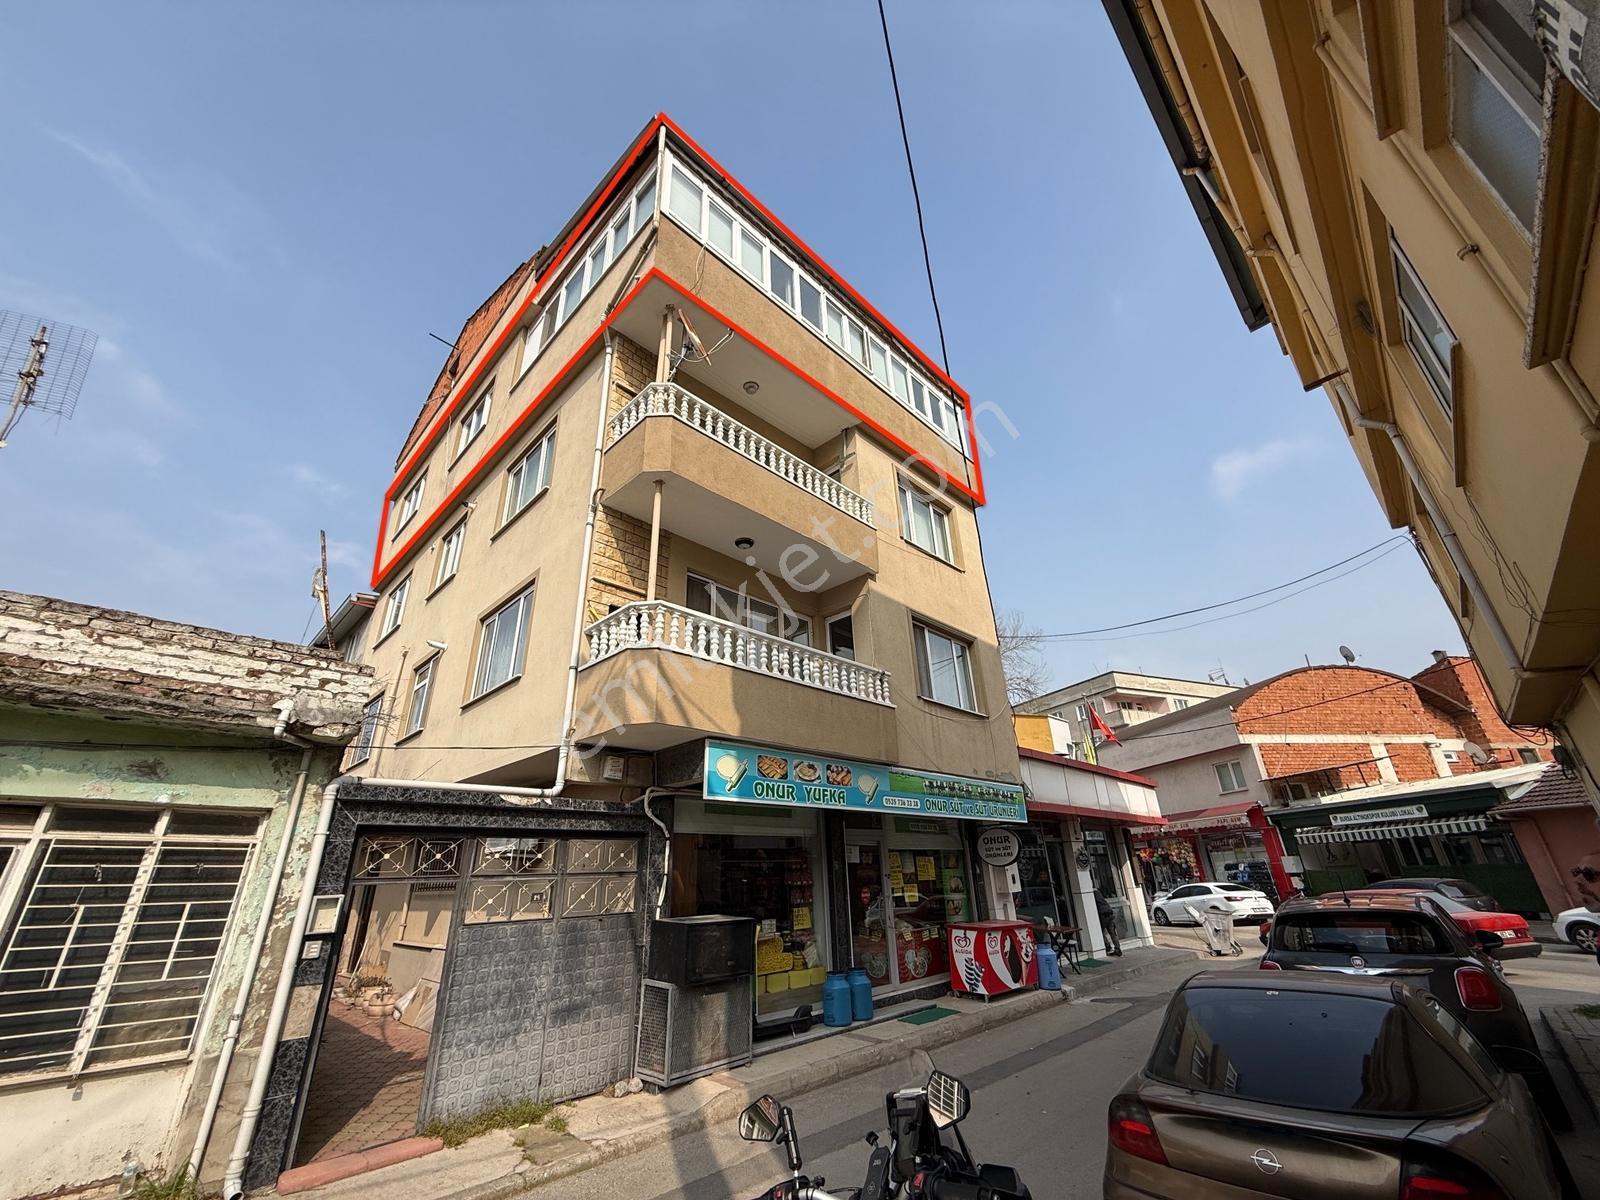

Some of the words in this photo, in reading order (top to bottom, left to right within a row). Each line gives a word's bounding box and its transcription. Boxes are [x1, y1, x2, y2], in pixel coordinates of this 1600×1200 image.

[753, 781, 796, 803] ONUR
[804, 785, 846, 806] YUFKA
[925, 798, 949, 813] ONUR
[950, 797, 964, 814] SÜT
[965, 804, 973, 814] ve
[974, 800, 987, 816] SÜT
[982, 835, 1011, 845] ONUR
